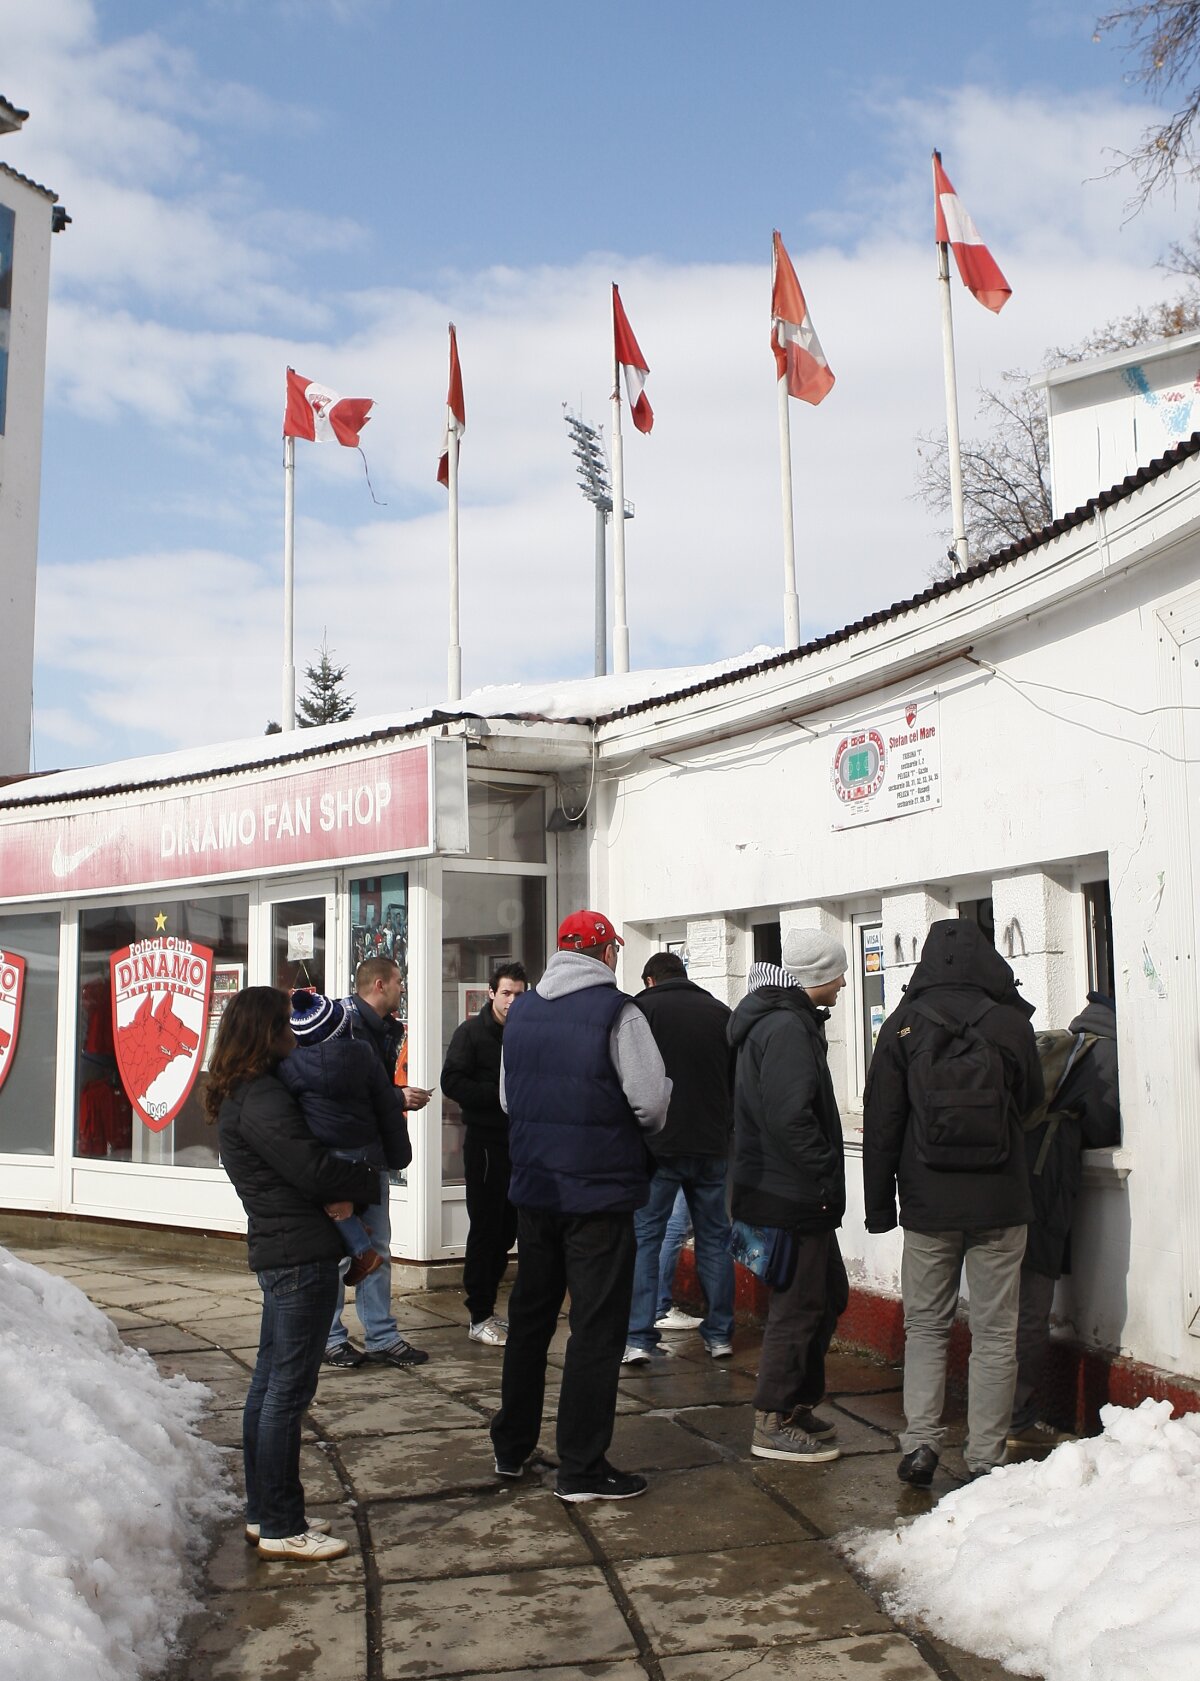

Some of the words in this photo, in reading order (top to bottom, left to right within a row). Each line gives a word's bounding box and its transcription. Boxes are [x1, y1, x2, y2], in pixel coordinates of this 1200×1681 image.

[909, 729, 918, 743] cel
[919, 726, 936, 740] Mare
[160, 808, 256, 859] DINAMO
[264, 797, 311, 841] FAN
[319, 782, 392, 832] SHOP
[129, 936, 163, 957] Fotbal
[166, 936, 193, 954] Club
[866, 934, 880, 944] VISA
[118, 951, 204, 989] DINAMO
